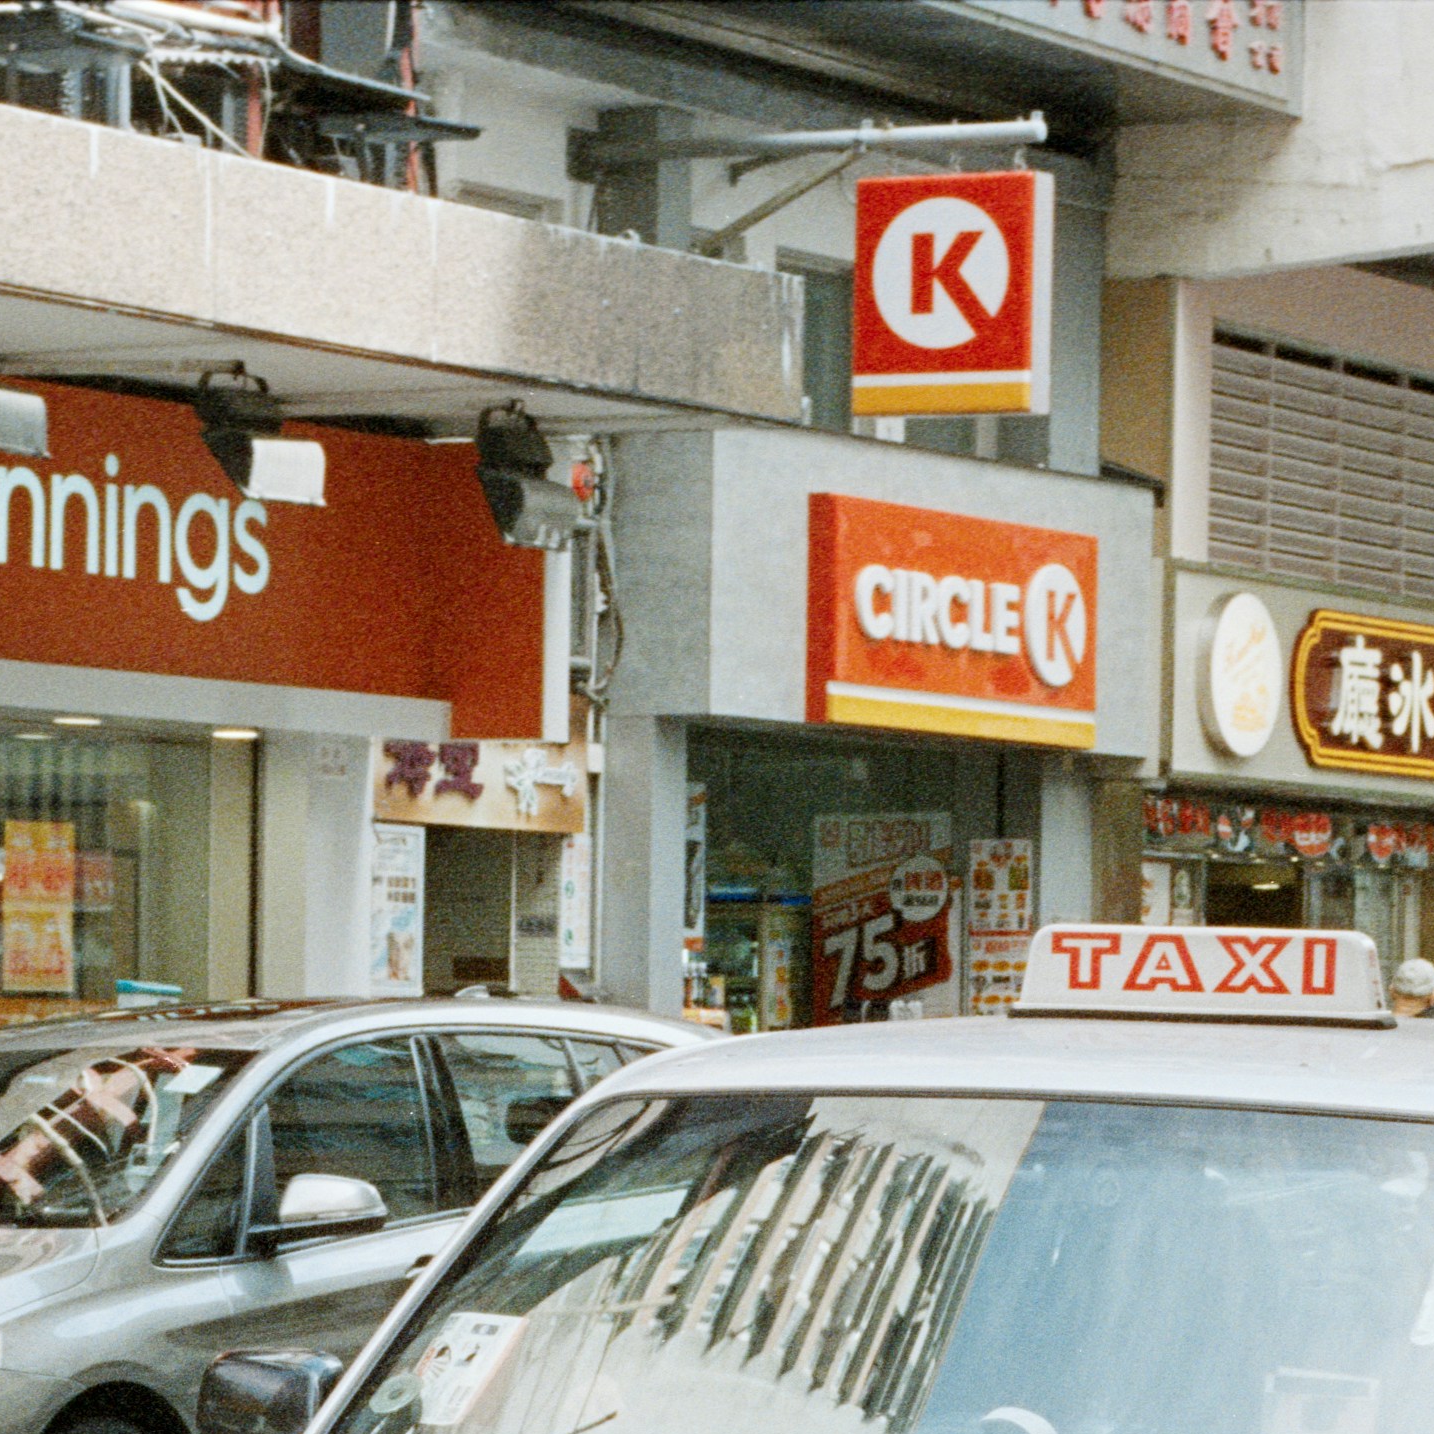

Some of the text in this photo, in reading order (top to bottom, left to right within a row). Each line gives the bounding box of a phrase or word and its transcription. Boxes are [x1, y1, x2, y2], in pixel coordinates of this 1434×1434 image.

[910, 230, 997, 339] K
[854, 562, 1021, 656] CIRCLE
[1051, 931, 1338, 996] TAXI
